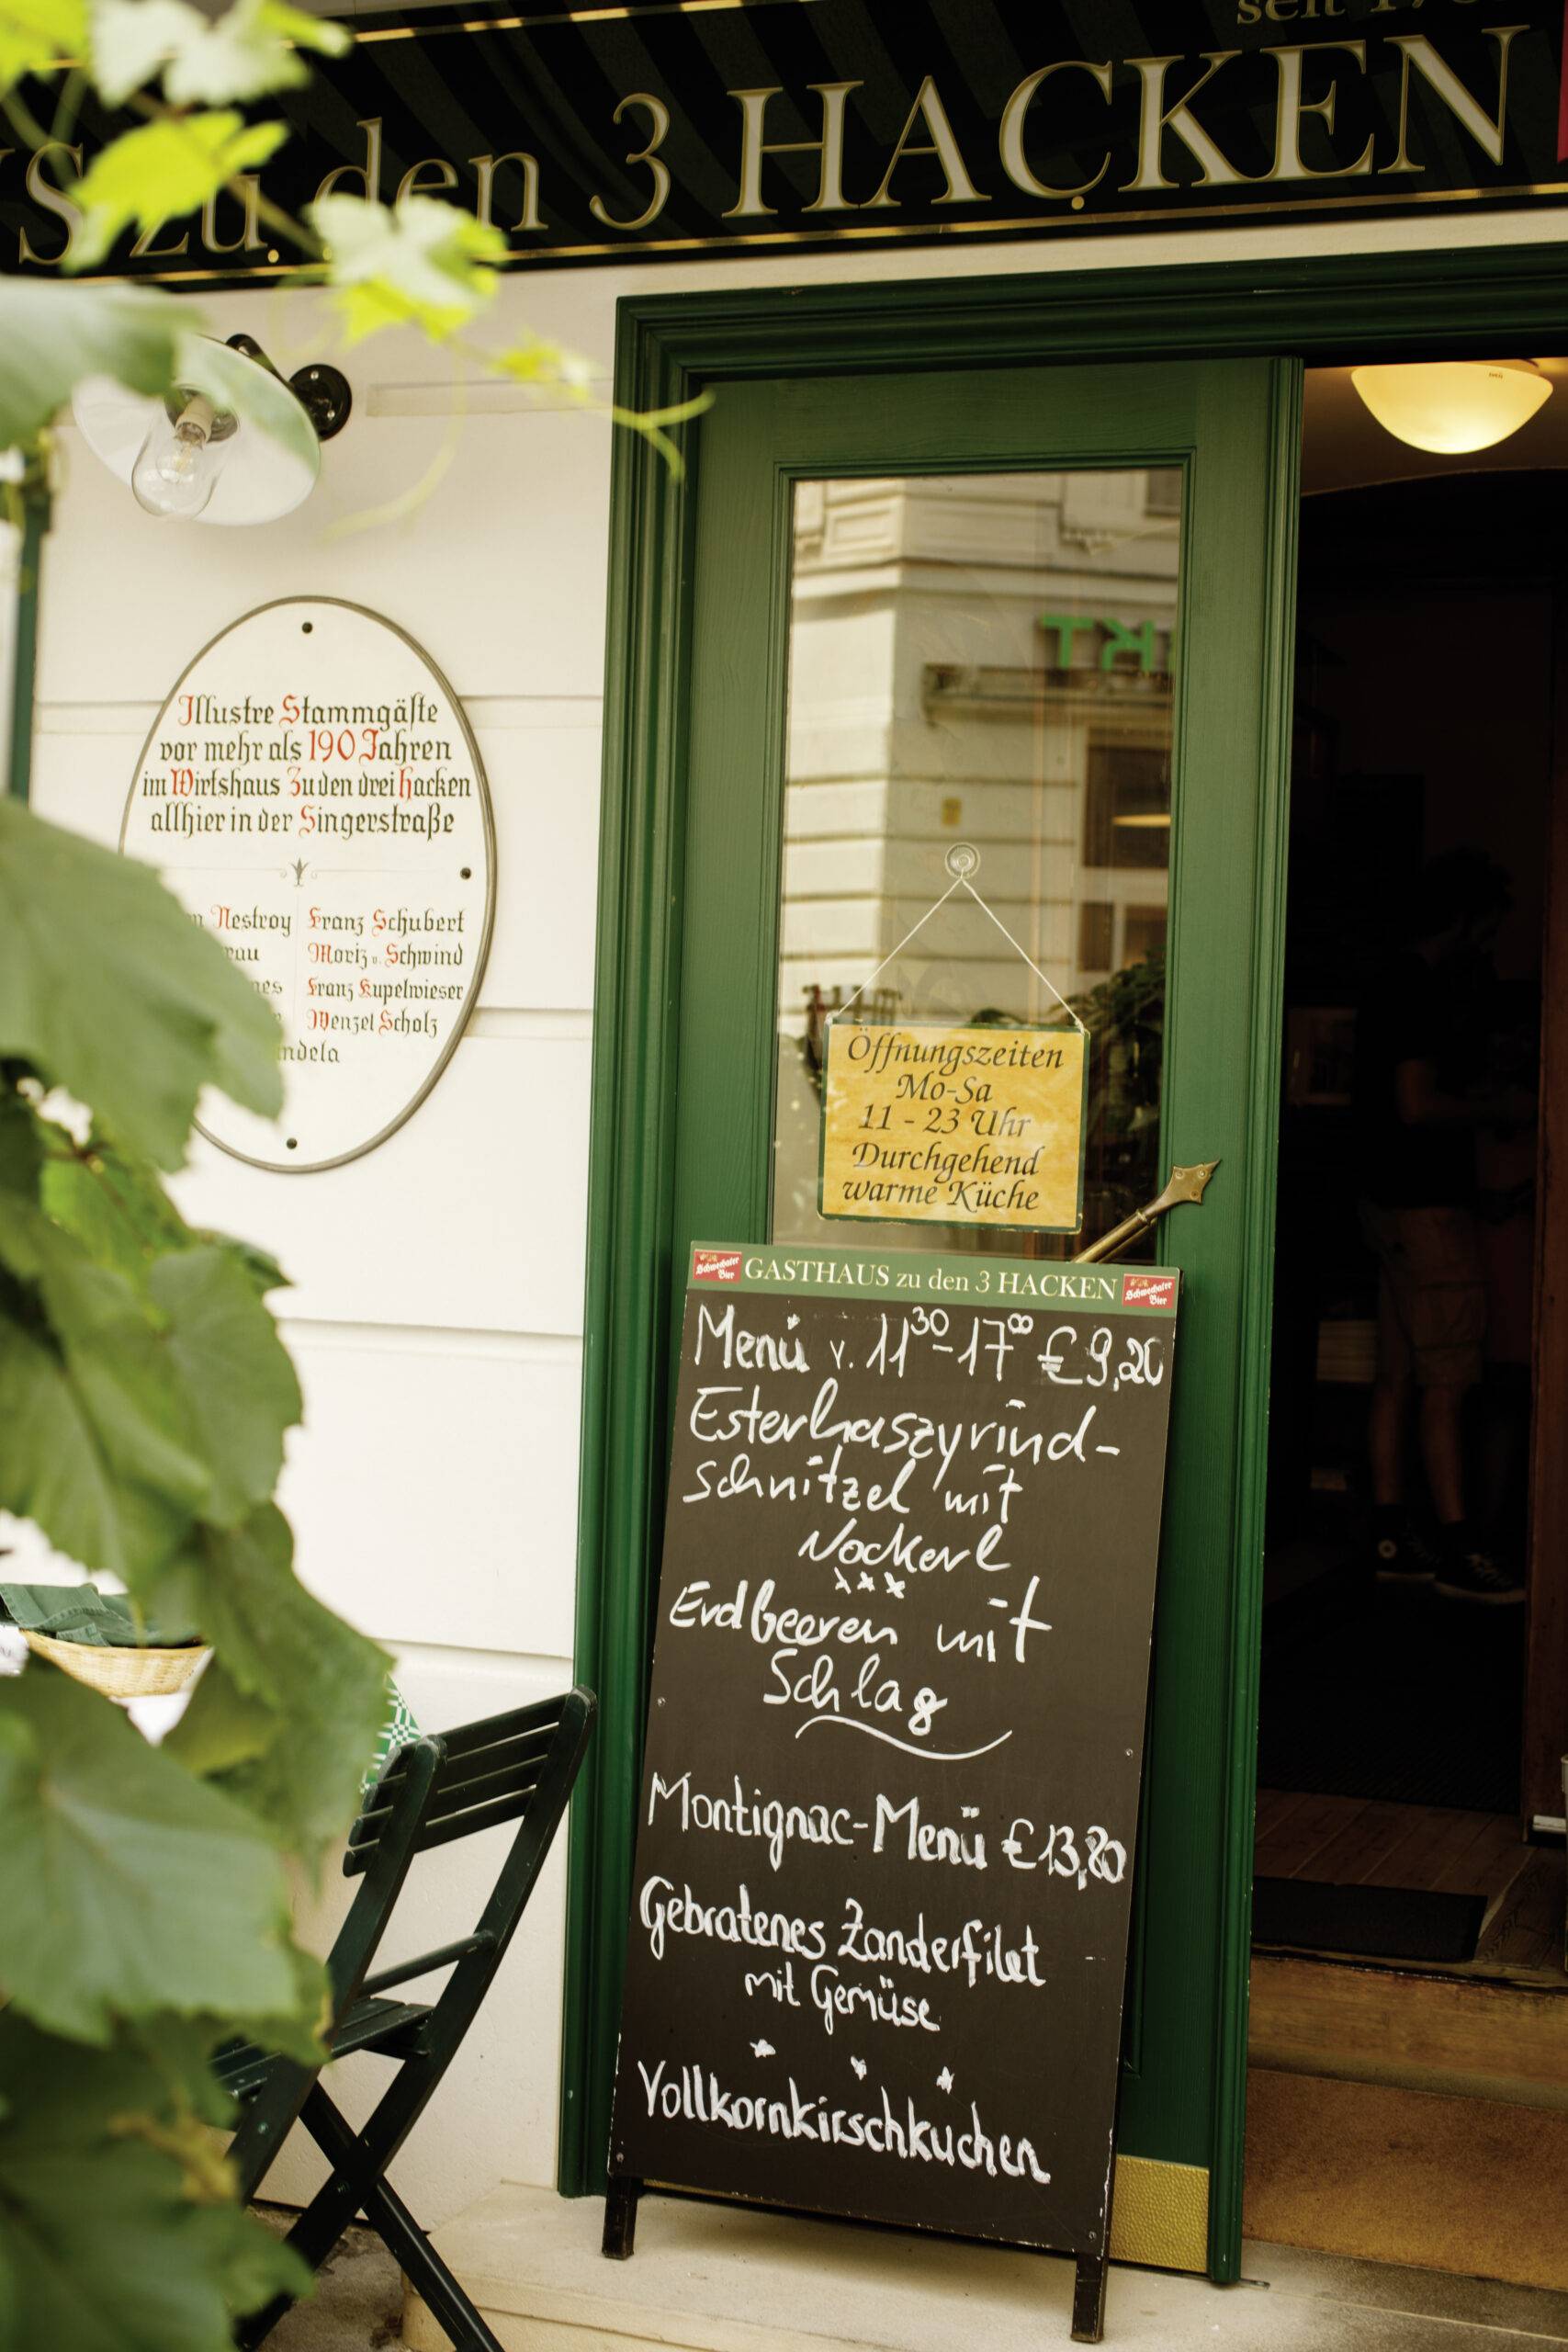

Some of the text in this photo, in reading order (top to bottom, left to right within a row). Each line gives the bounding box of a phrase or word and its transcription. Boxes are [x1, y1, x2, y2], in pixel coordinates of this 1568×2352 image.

[313, 117, 550, 235] den
[589, 92, 671, 231] 3
[721, 24, 1531, 219] HACKEN
[177, 694, 275, 726] Illustre
[160, 729, 453, 766] vor mehr als 190 Jahren
[141, 770, 167, 797] im
[170, 766, 281, 799] Wirtshaus
[318, 770, 354, 797] den
[357, 770, 396, 797] drei
[151, 801, 455, 842] allhier in der Singerstraße
[210, 904, 292, 939] Nestroy
[309, 906, 466, 939] Franz Schubert
[384, 942, 464, 971] Schwind
[308, 976, 464, 1007] Franz Kupelwieser
[307, 1008, 375, 1035] Wenzel
[378, 1007, 439, 1039] Scholz
[847, 1026, 1065, 1077] Öffnungszeiten
[895, 1070, 993, 1105] Mo-Sa
[858, 1102, 892, 1131] 11
[922, 1106, 960, 1135] 23
[970, 1105, 1032, 1137] Uhr
[852, 1141, 1046, 1185] Durchgehend
[841, 1179, 1040, 1214] warme Küche
[744, 1257, 1119, 1302] GASTHAUS zu den 3 HACKEN
[693, 1304, 811, 1374] Menü
[944, 1463, 1023, 1523] mit
[797, 1517, 1012, 1574] Nockerl
[669, 1575, 1053, 1664] Erdbeeren mit
[763, 1648, 949, 1736] Schlag
[639, 1875, 1047, 1988] Gebratenes Zanderfilet
[743, 1961, 941, 2035] mit Gemüse
[637, 2059, 1051, 2185] Vollkornkirschkuchen
